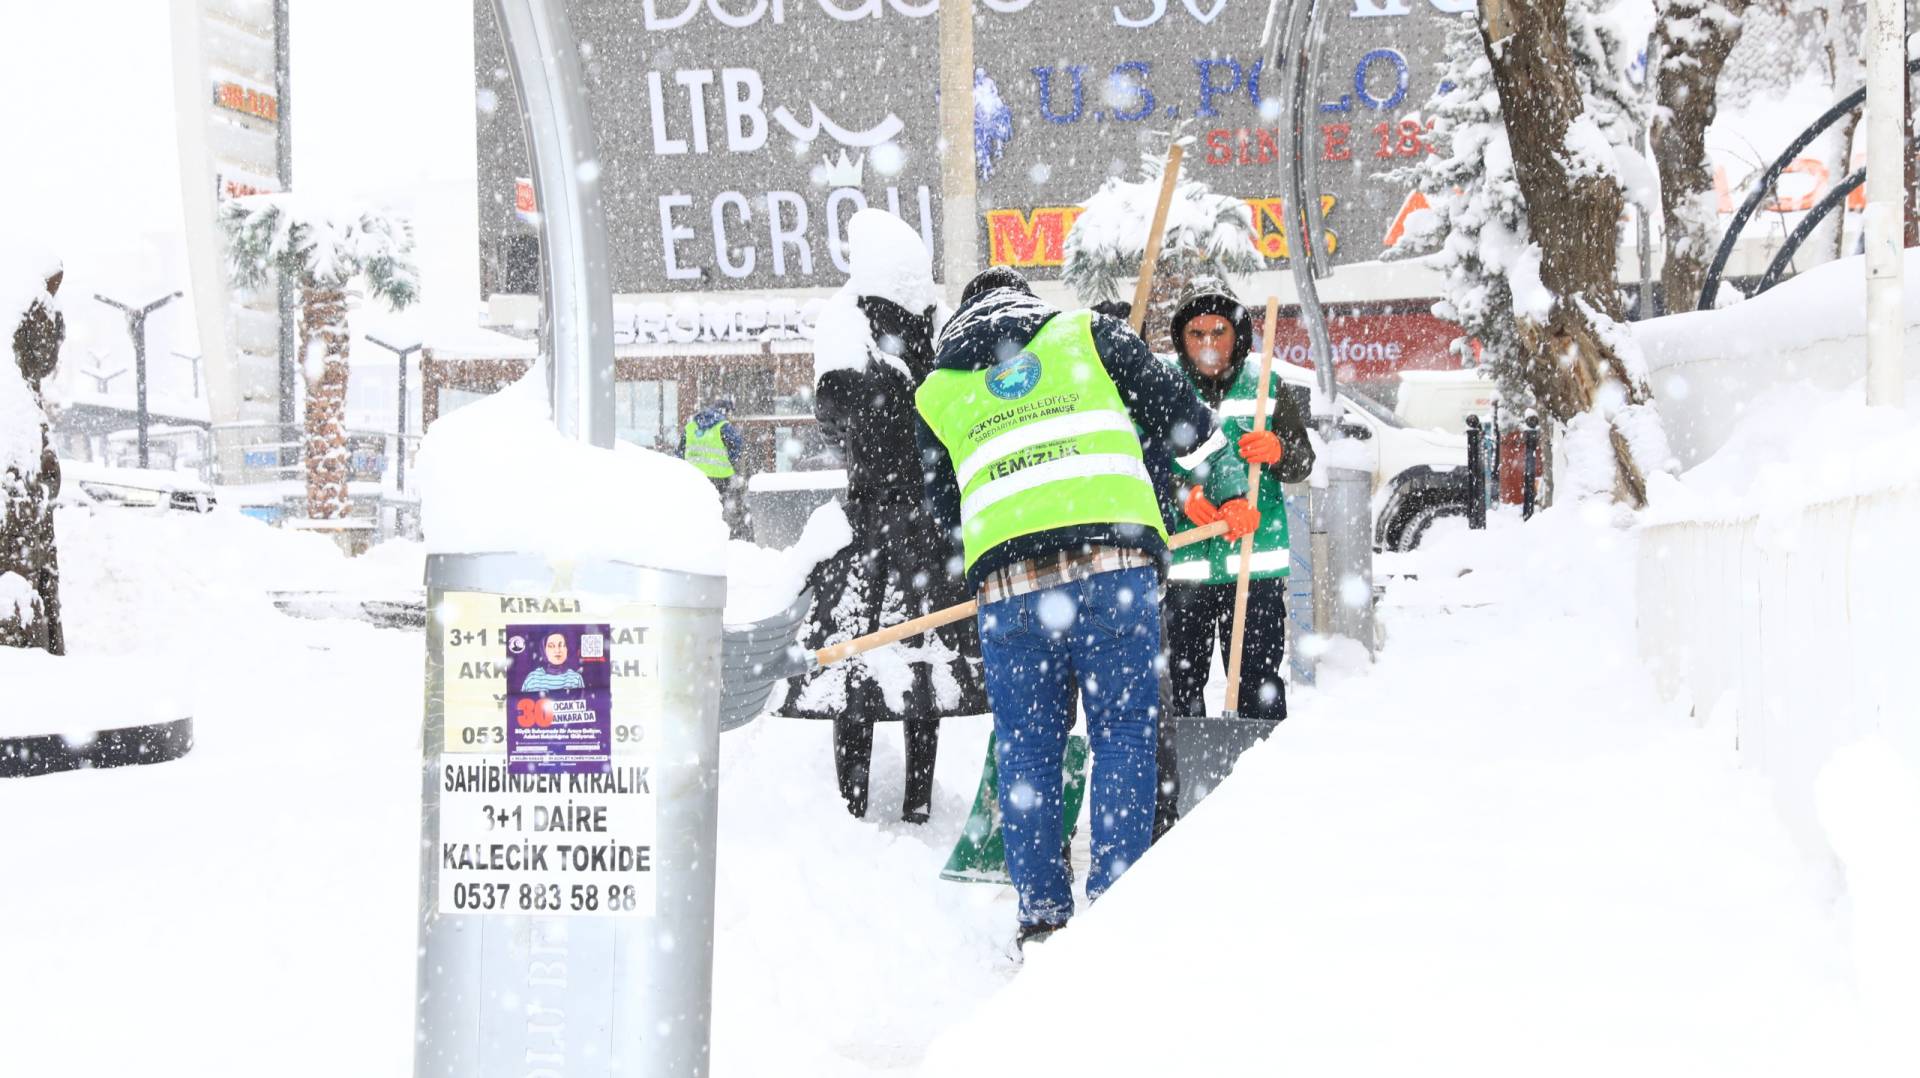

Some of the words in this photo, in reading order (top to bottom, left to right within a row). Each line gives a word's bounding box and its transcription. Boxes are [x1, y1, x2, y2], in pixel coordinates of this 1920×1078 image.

[1193, 47, 1410, 119] PO
[648, 67, 768, 154] LTB
[1206, 122, 1352, 167] SINE
[1373, 117, 1439, 159] 18
[1273, 335, 1403, 363] vofone
[450, 628, 487, 647] 3+1
[517, 698, 553, 728] 30
[462, 726, 507, 745] 053
[483, 804, 523, 832] 3+1
[534, 799, 608, 833] DAİRE
[443, 838, 549, 872] KALECİK
[557, 838, 651, 873] TOKİDE
[454, 882, 511, 910] 0537
[519, 883, 562, 911] 883
[570, 884, 599, 911] 58
[607, 884, 637, 912] 88
